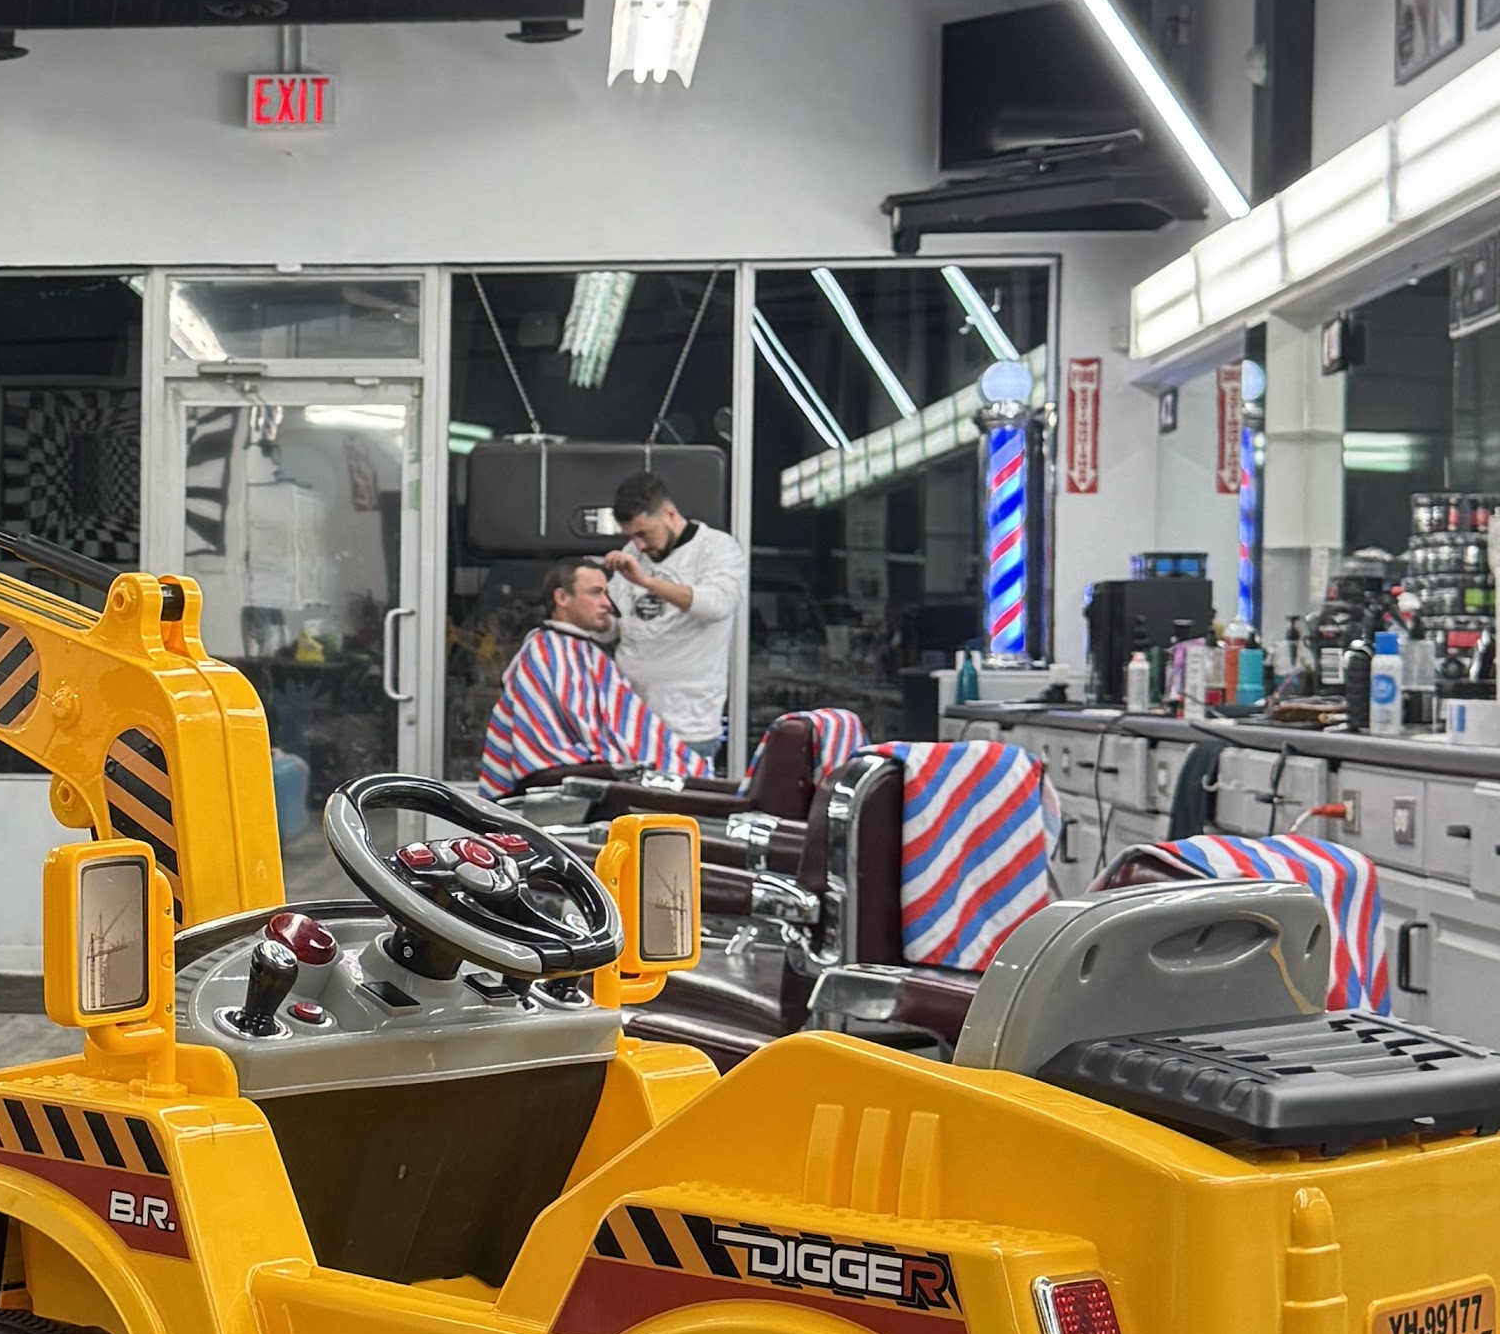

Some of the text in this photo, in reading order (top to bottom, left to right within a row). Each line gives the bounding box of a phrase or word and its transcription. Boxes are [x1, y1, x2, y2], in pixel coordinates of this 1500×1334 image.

[253, 77, 330, 124] EXIT
[109, 1190, 176, 1231] B.R.
[717, 1229, 945, 1302] DIGGER
